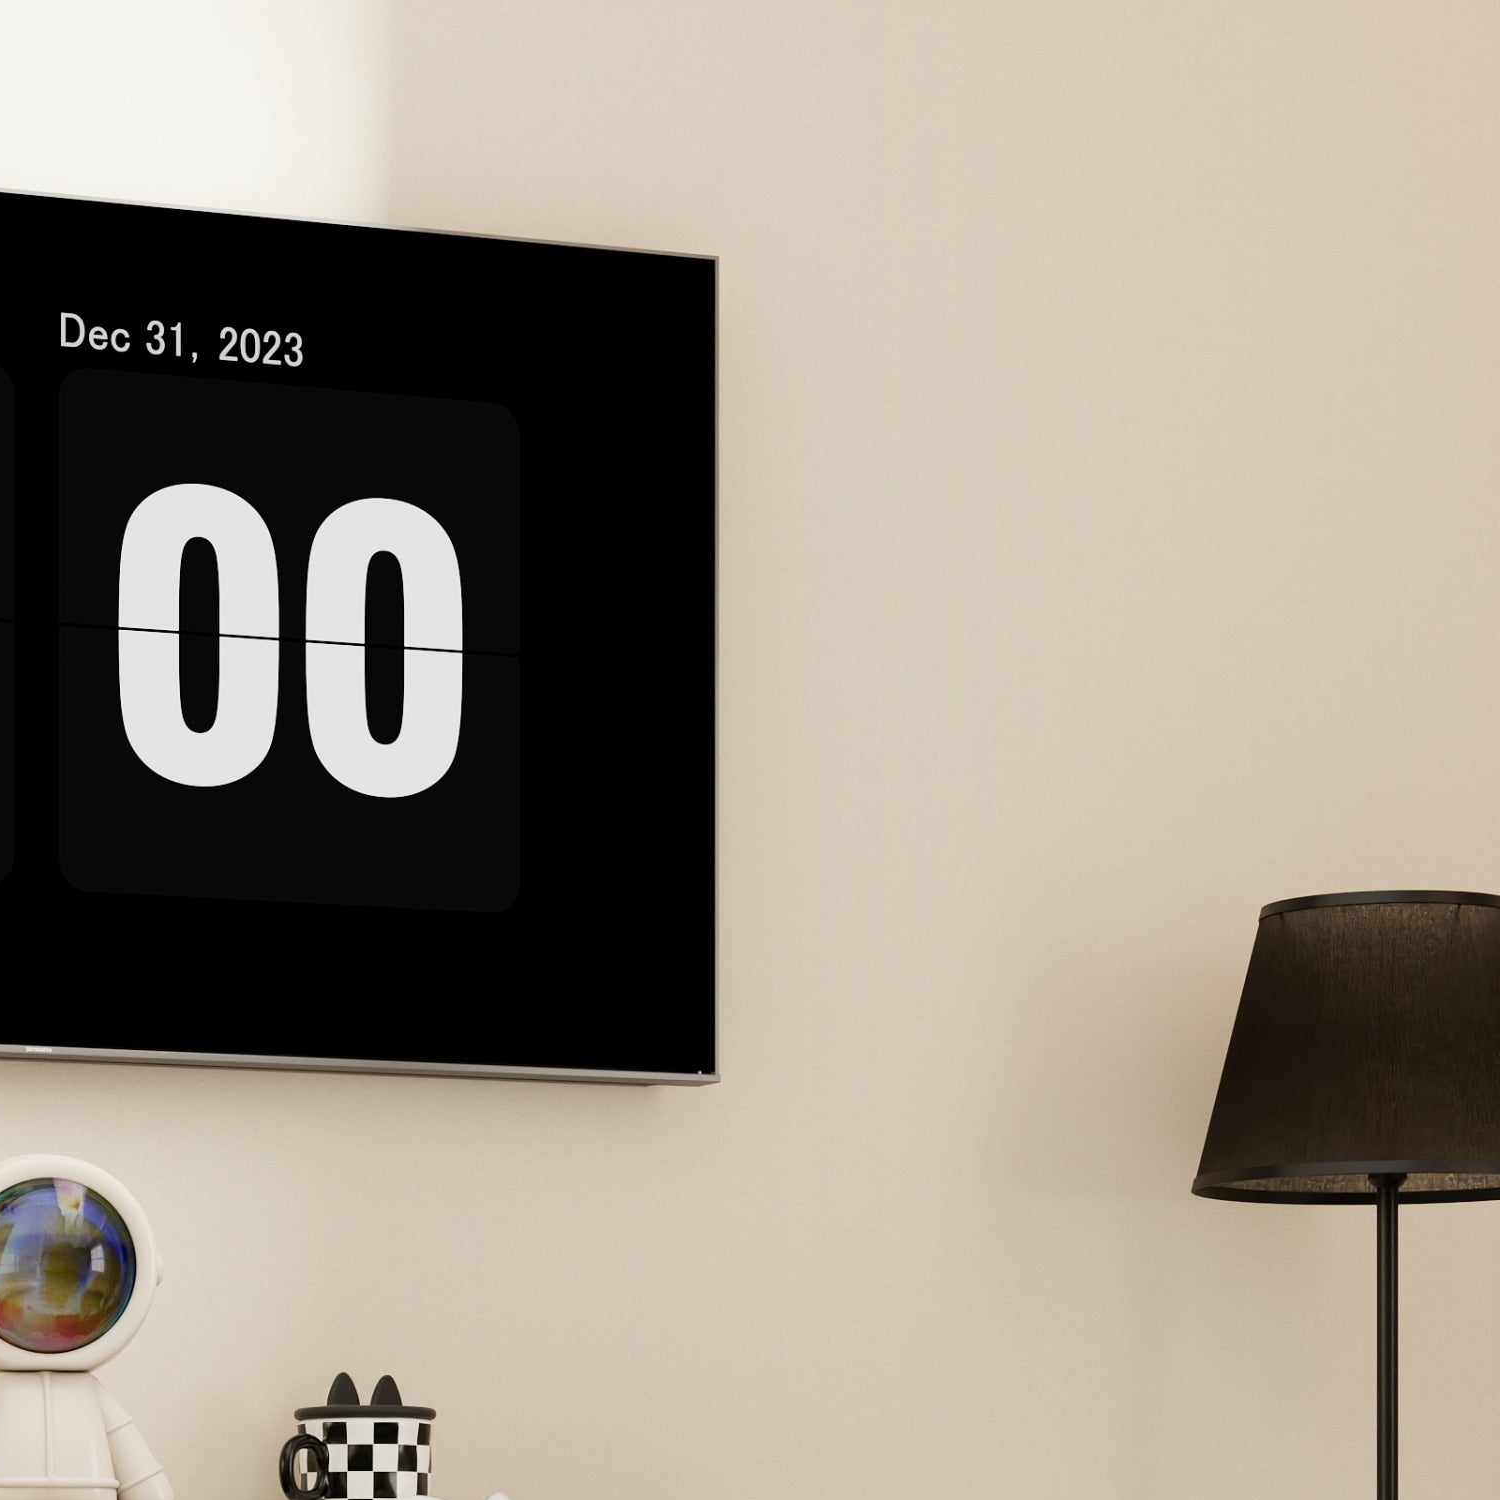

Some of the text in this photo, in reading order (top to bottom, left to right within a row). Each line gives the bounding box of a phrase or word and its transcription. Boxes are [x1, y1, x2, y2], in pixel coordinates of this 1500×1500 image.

[60, 311, 304, 368] Dec 31, 2023
[118, 484, 464, 798] 00
